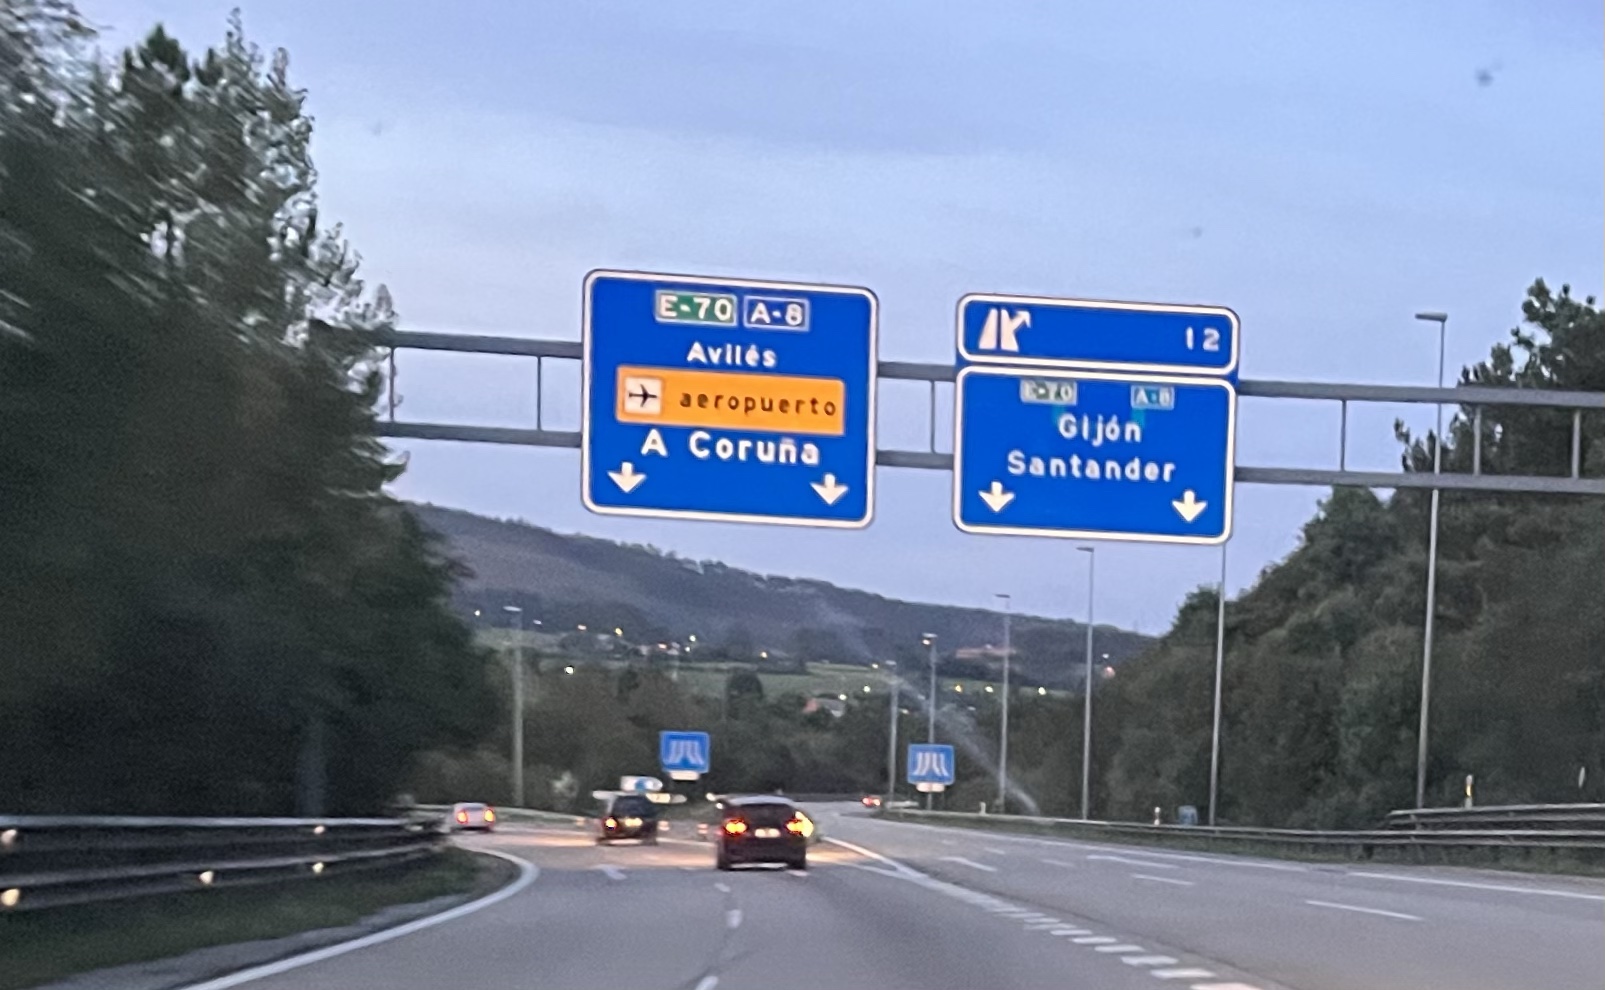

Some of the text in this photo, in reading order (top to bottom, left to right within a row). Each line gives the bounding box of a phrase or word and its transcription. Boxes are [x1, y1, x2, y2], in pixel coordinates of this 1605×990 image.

[658, 294, 733, 321] E-70
[750, 302, 804, 326] A-8
[1185, 327, 1220, 351] 12
[686, 341, 777, 367] Avilés
[680, 391, 836, 416] aeropuerto
[1058, 413, 1141, 447] Gijón
[641, 429, 820, 464] A Coruña
[1007, 449, 1176, 482] Santander
